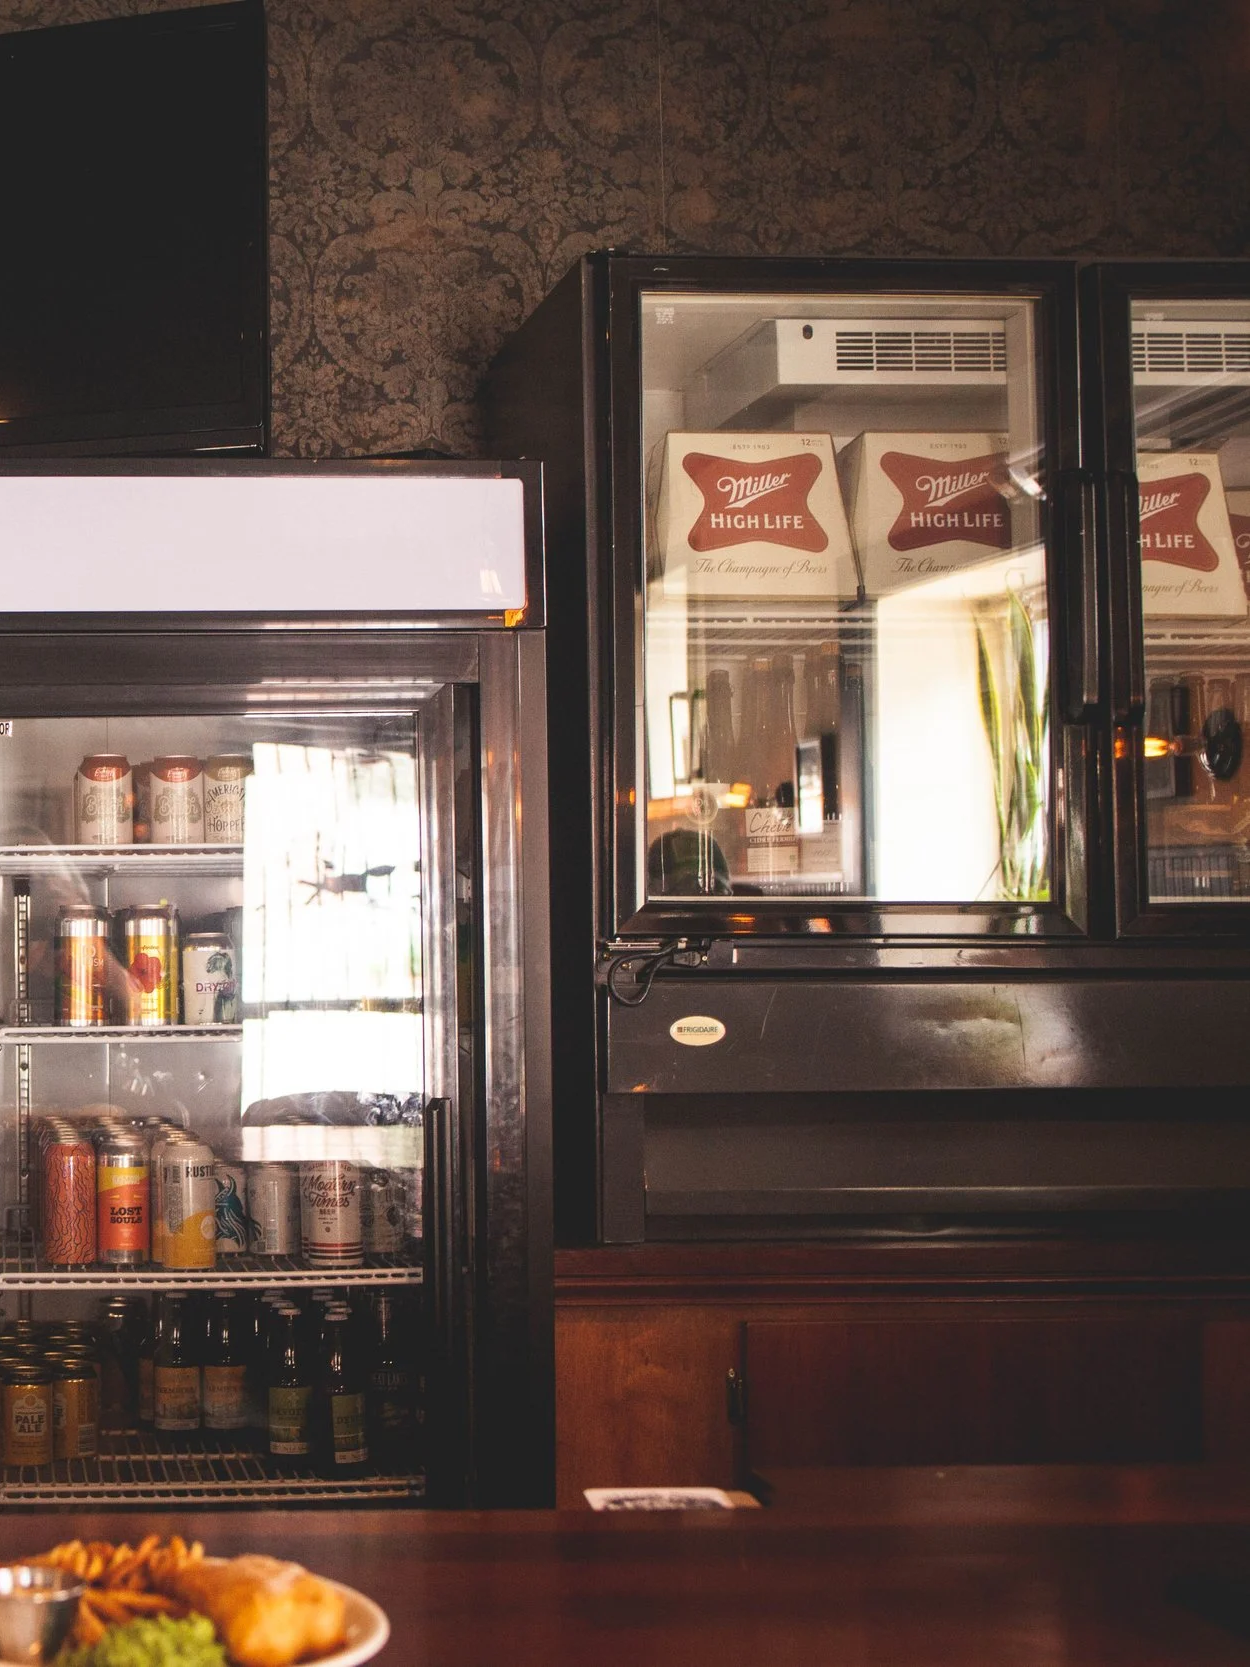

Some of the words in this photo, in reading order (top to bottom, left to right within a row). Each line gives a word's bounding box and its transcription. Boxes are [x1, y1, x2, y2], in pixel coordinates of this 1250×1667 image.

[716, 472, 792, 509] Miller
[915, 472, 990, 508] Miller
[1139, 492, 1181, 522] iller
[710, 513, 759, 529] HIGH
[764, 514, 804, 529] LIFE
[910, 512, 958, 527] HIGH
[963, 512, 1003, 528] LIFE
[1155, 533, 1195, 549] LIFE
[717, 558, 779, 578] Champagne
[110, 1206, 143, 1216] LOST
[110, 1216, 143, 1224] SOULS
[15, 1415, 45, 1424] PALE
[18, 1424, 43, 1433] ALE
